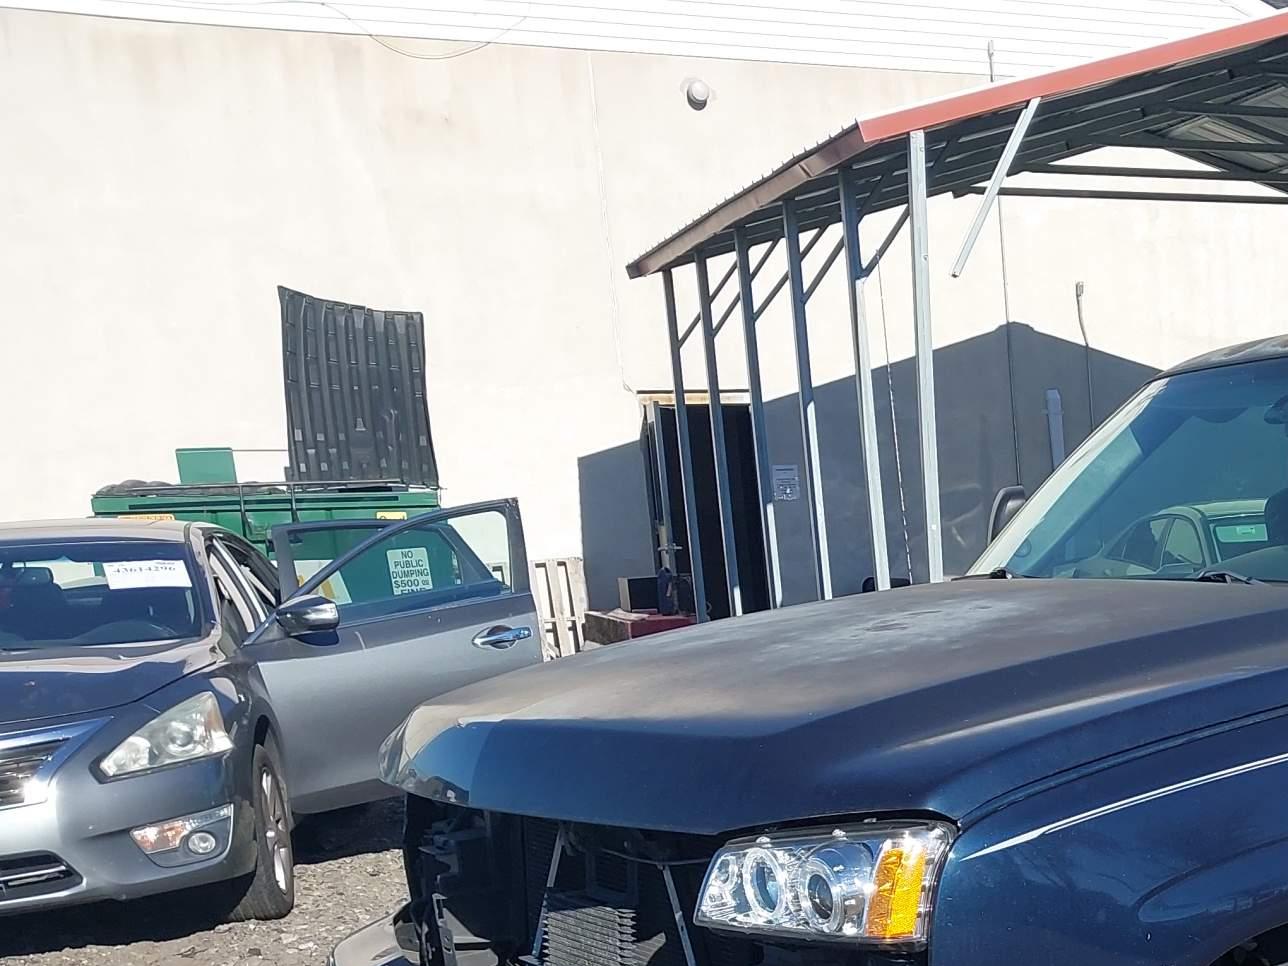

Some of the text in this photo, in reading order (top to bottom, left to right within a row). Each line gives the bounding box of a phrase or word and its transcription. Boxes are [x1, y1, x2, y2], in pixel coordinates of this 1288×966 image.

[401, 550, 413, 559] NO
[393, 559, 424, 569] PUBLIC
[391, 568, 430, 579] DUMPING
[393, 579, 420, 588] $500
